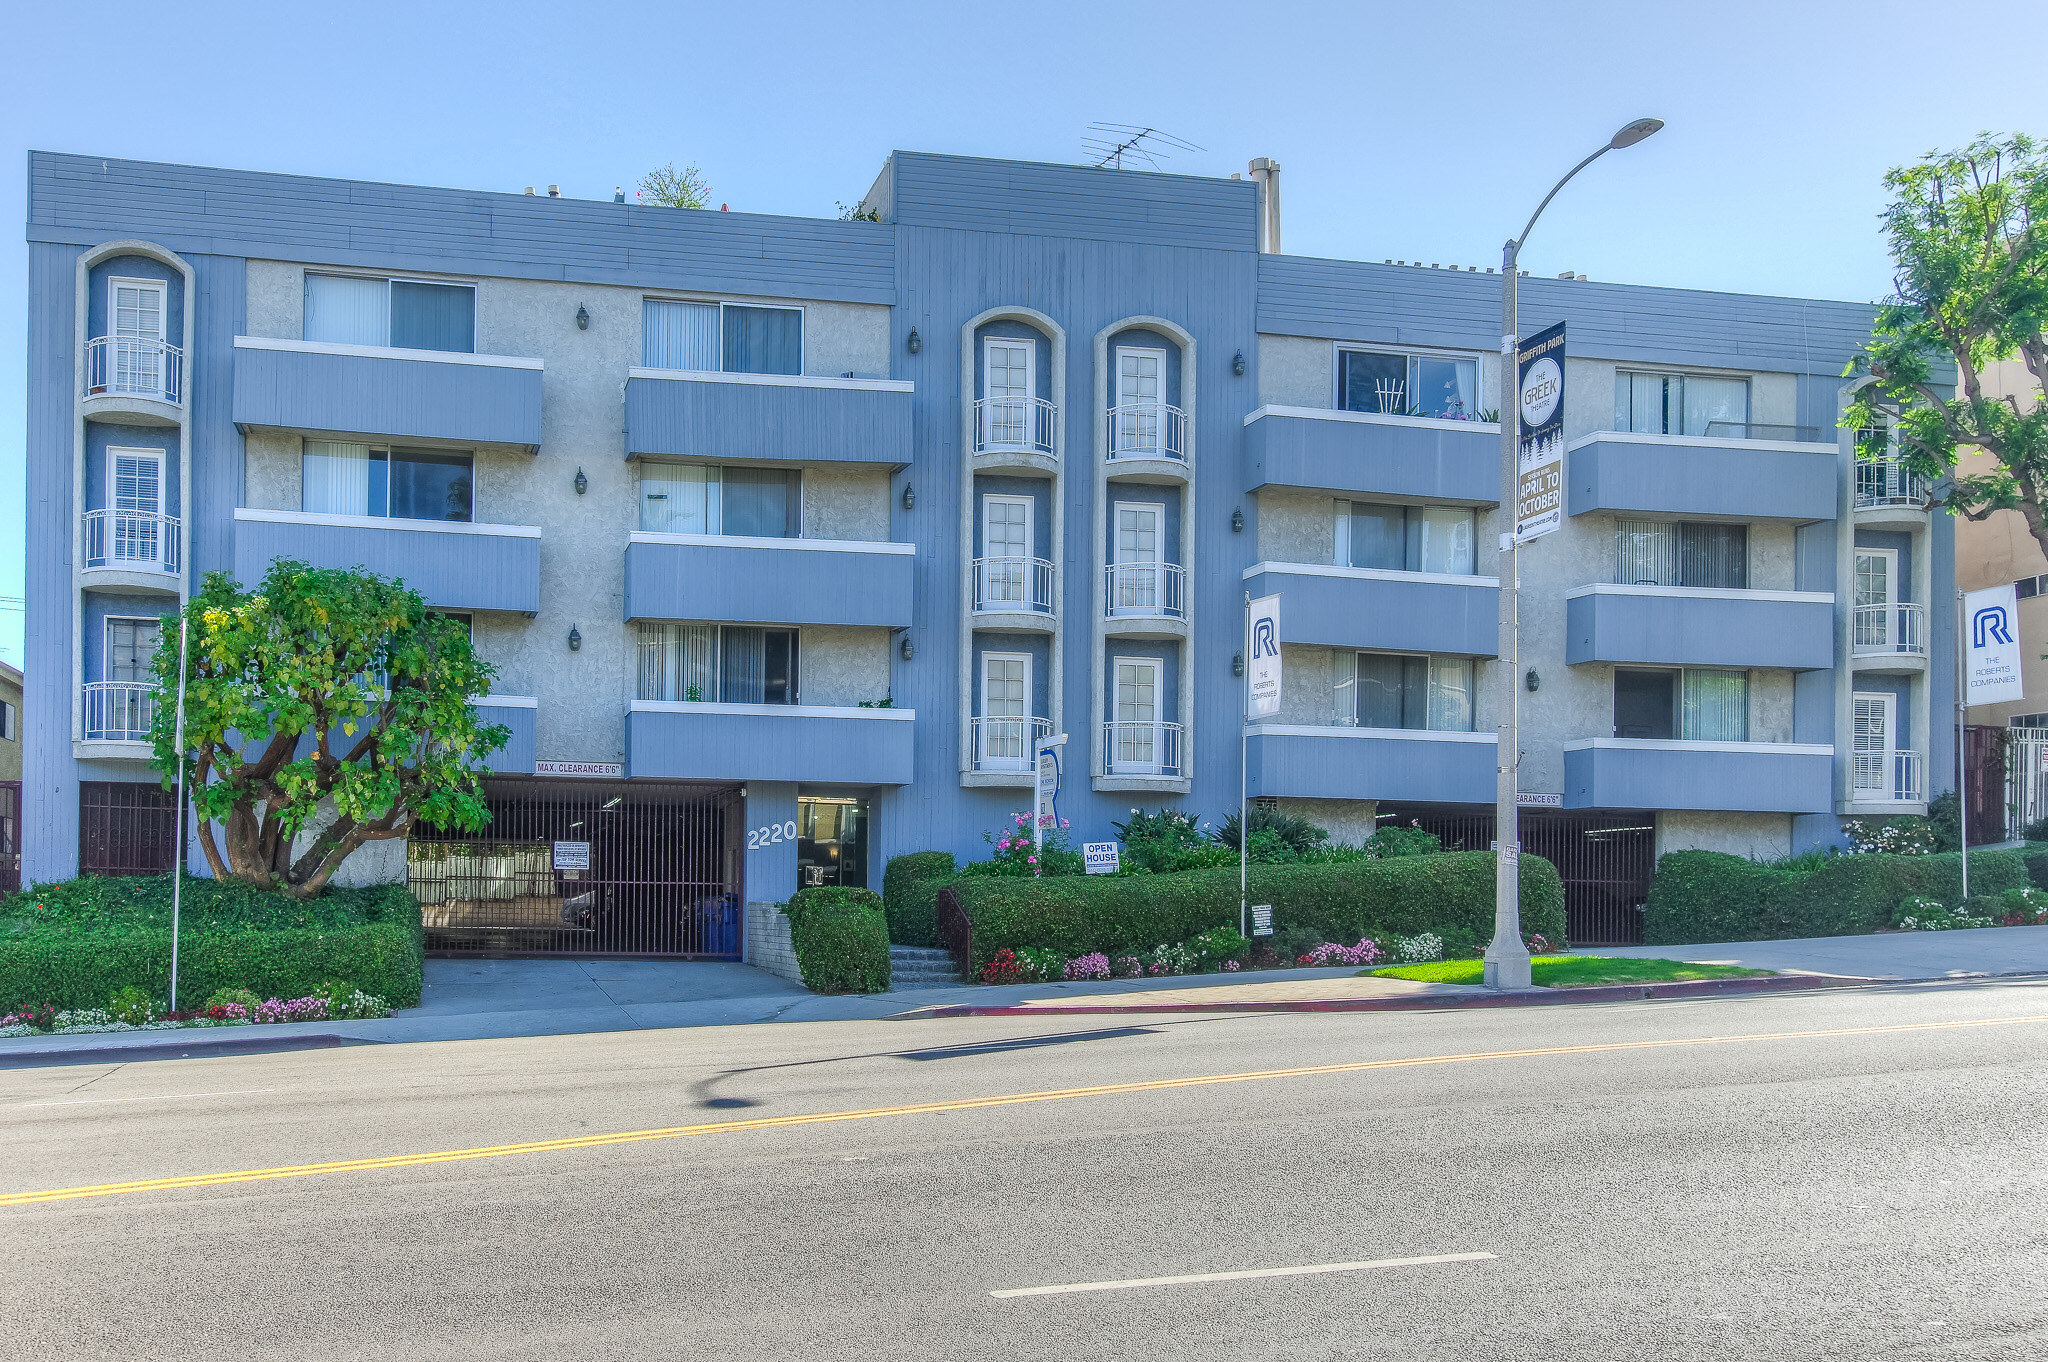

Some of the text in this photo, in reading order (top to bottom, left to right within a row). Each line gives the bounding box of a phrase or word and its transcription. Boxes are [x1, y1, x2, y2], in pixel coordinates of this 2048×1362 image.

[1519, 333, 1565, 364] GRIFFITH PARK
[1536, 371, 1546, 382] THE
[1524, 377, 1557, 405] GREEK
[1530, 398, 1550, 412] THEATRE
[1520, 471, 1559, 500] APRIL TO
[1519, 489, 1559, 517] OCTOBER
[1985, 656, 2000, 665] THE
[1975, 665, 2011, 677] ROBERTS
[1253, 680, 1275, 691] ROBERTS
[1970, 675, 2016, 688] COMPANIES
[537, 763, 557, 772] MAX.
[558, 763, 604, 774] CLEARANCE
[1516, 794, 1546, 804] EARANCE
[747, 820, 797, 850] 2220
[1088, 843, 1113, 853] OPEN
[1086, 853, 1117, 862] HOUSE
